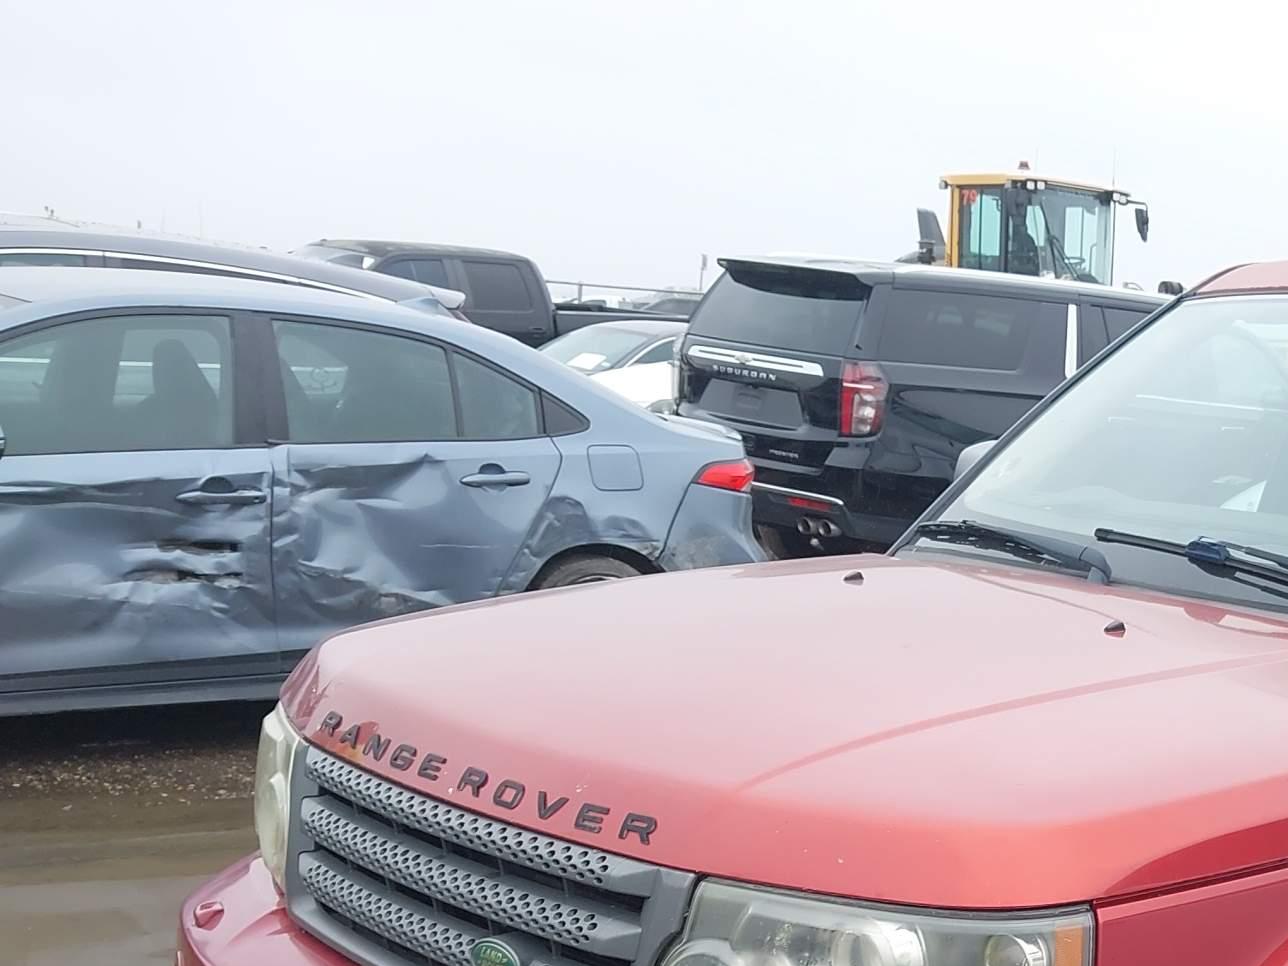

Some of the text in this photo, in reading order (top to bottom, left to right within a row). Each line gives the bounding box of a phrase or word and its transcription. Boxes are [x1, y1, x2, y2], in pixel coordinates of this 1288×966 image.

[961, 189, 978, 206] 79
[712, 364, 777, 381] SUBURBAN
[320, 710, 658, 846] RANGE ROVER
